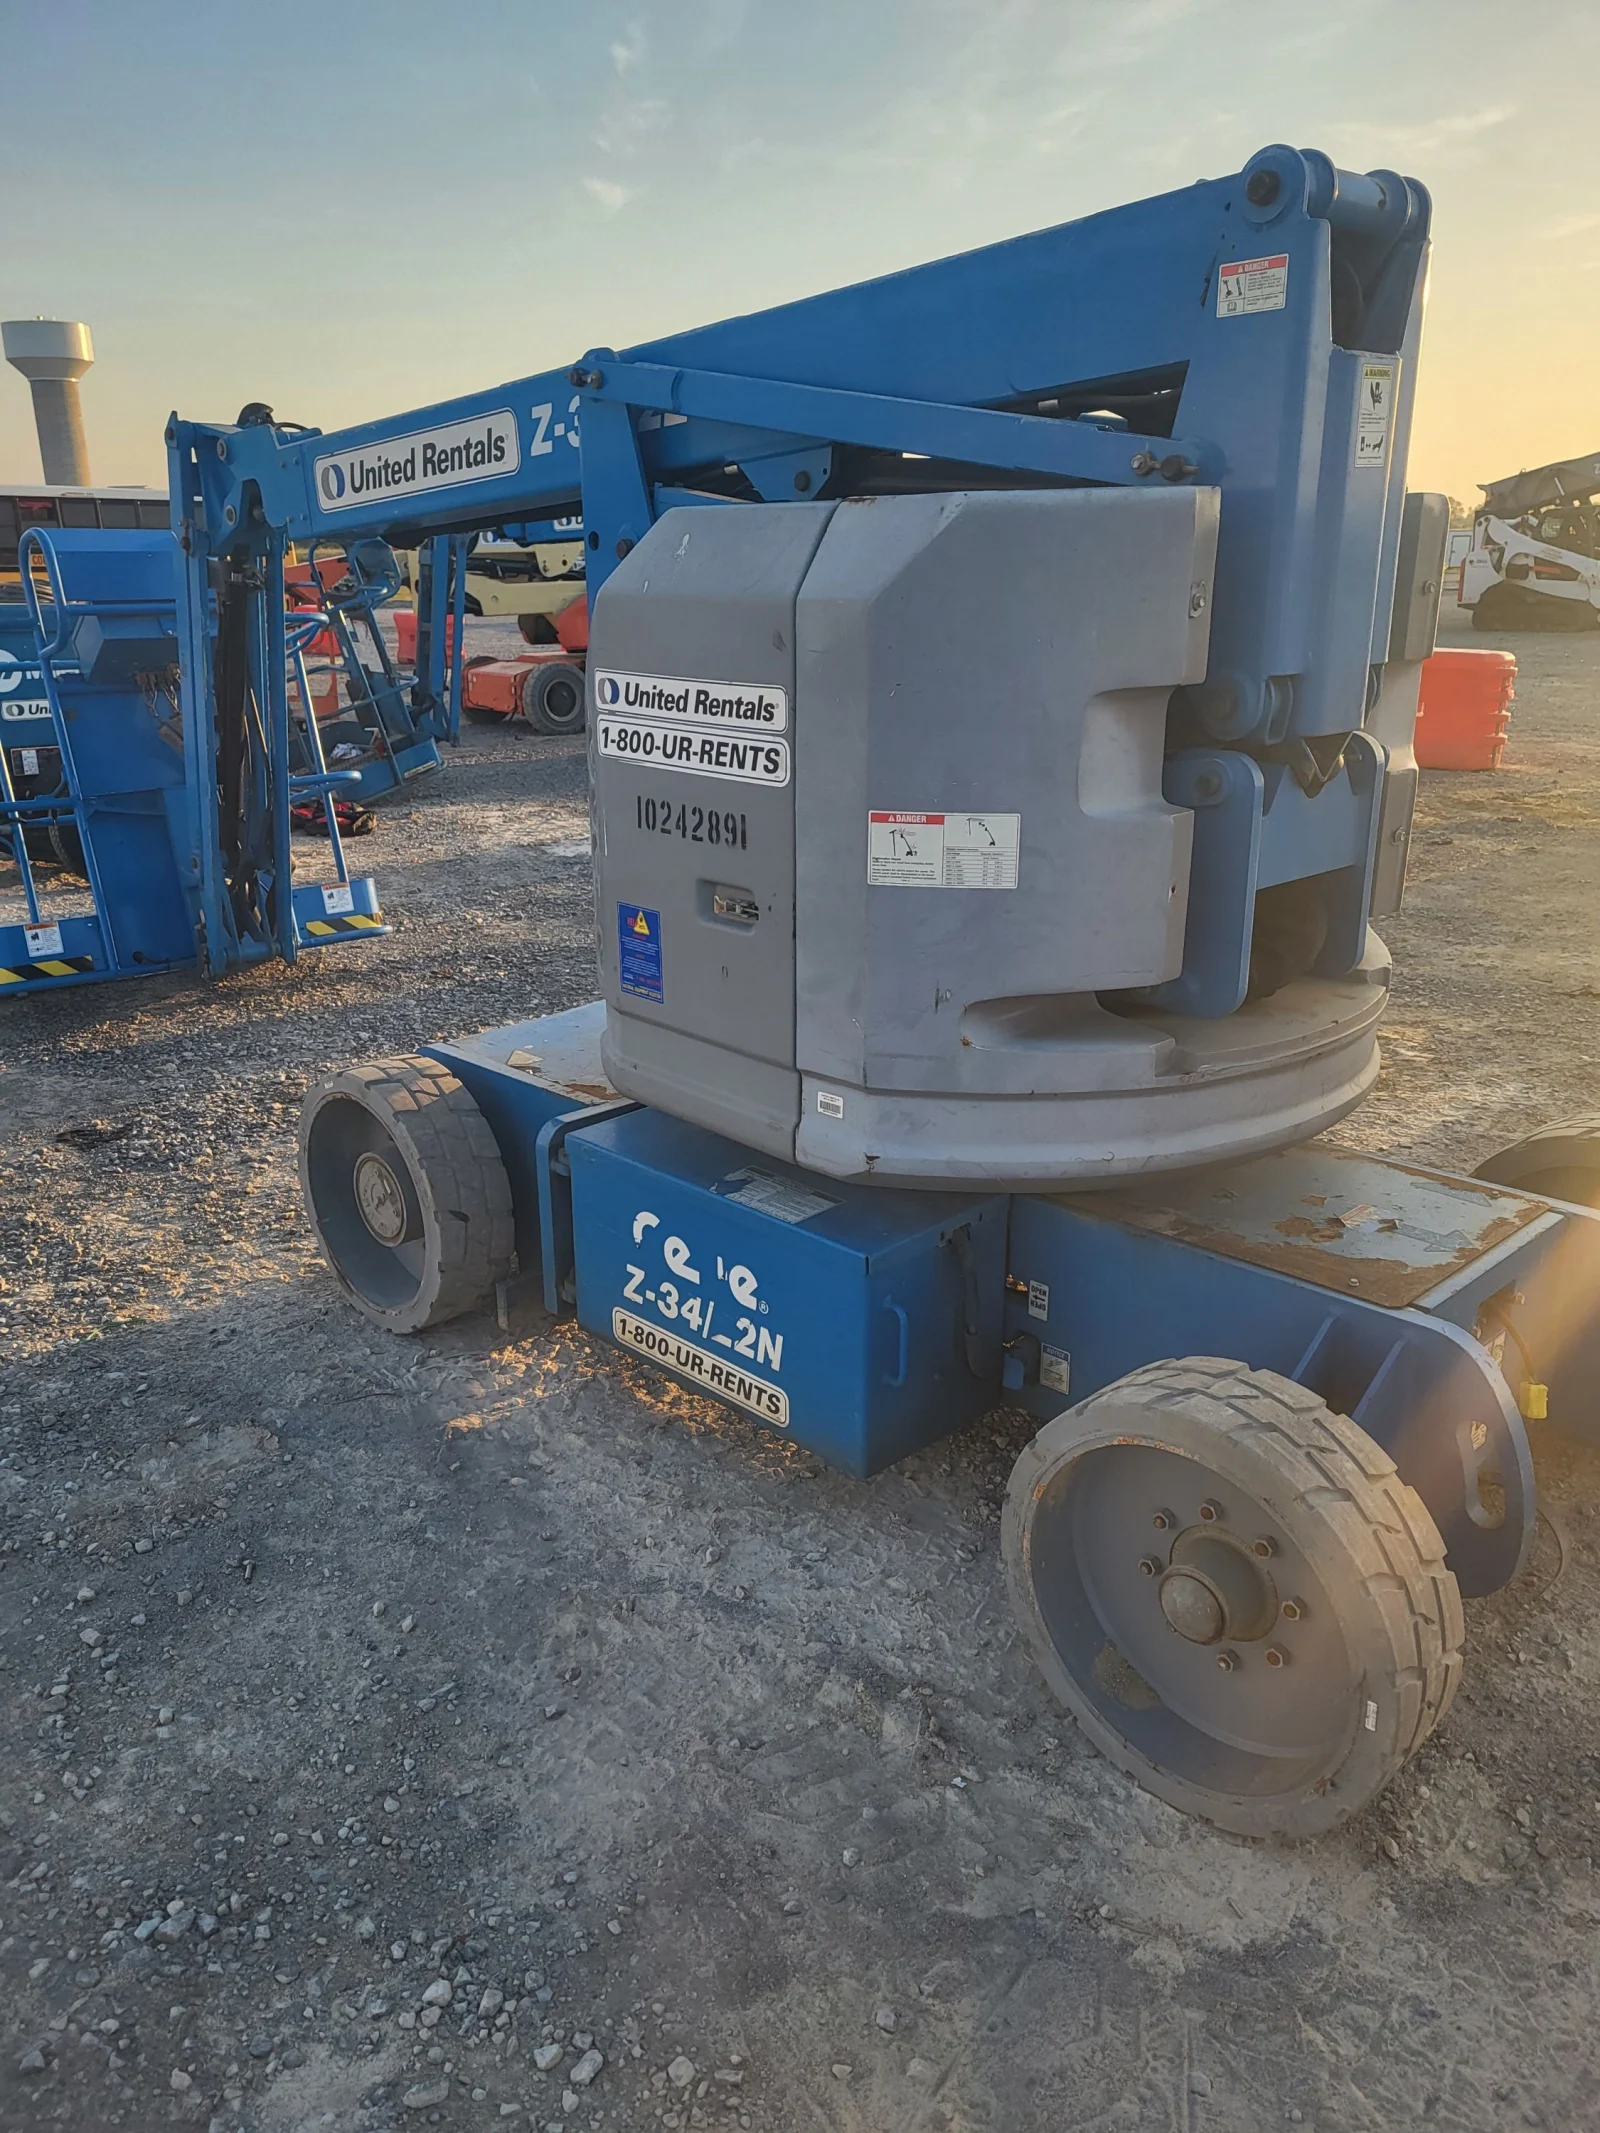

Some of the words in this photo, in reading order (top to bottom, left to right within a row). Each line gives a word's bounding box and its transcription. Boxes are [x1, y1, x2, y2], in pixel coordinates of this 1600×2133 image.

[1244, 260, 1269, 271] DANGER
[1369, 369, 1391, 377] WARNING
[350, 454, 416, 494] United
[422, 427, 506, 477] Rentals
[624, 681, 690, 713] United
[694, 689, 776, 722] Rentals
[601, 726, 781, 775] 1-800-UR-RENTS
[636, 795, 748, 851] 10242891
[895, 814, 927, 823] DANGER
[1030, 1285, 1047, 1298] OPEN
[622, 1263, 784, 1372] Z-34/2N
[618, 1317, 782, 1416] 1-800-UR-RENTS
[1046, 1347, 1065, 1359] NOTICE
